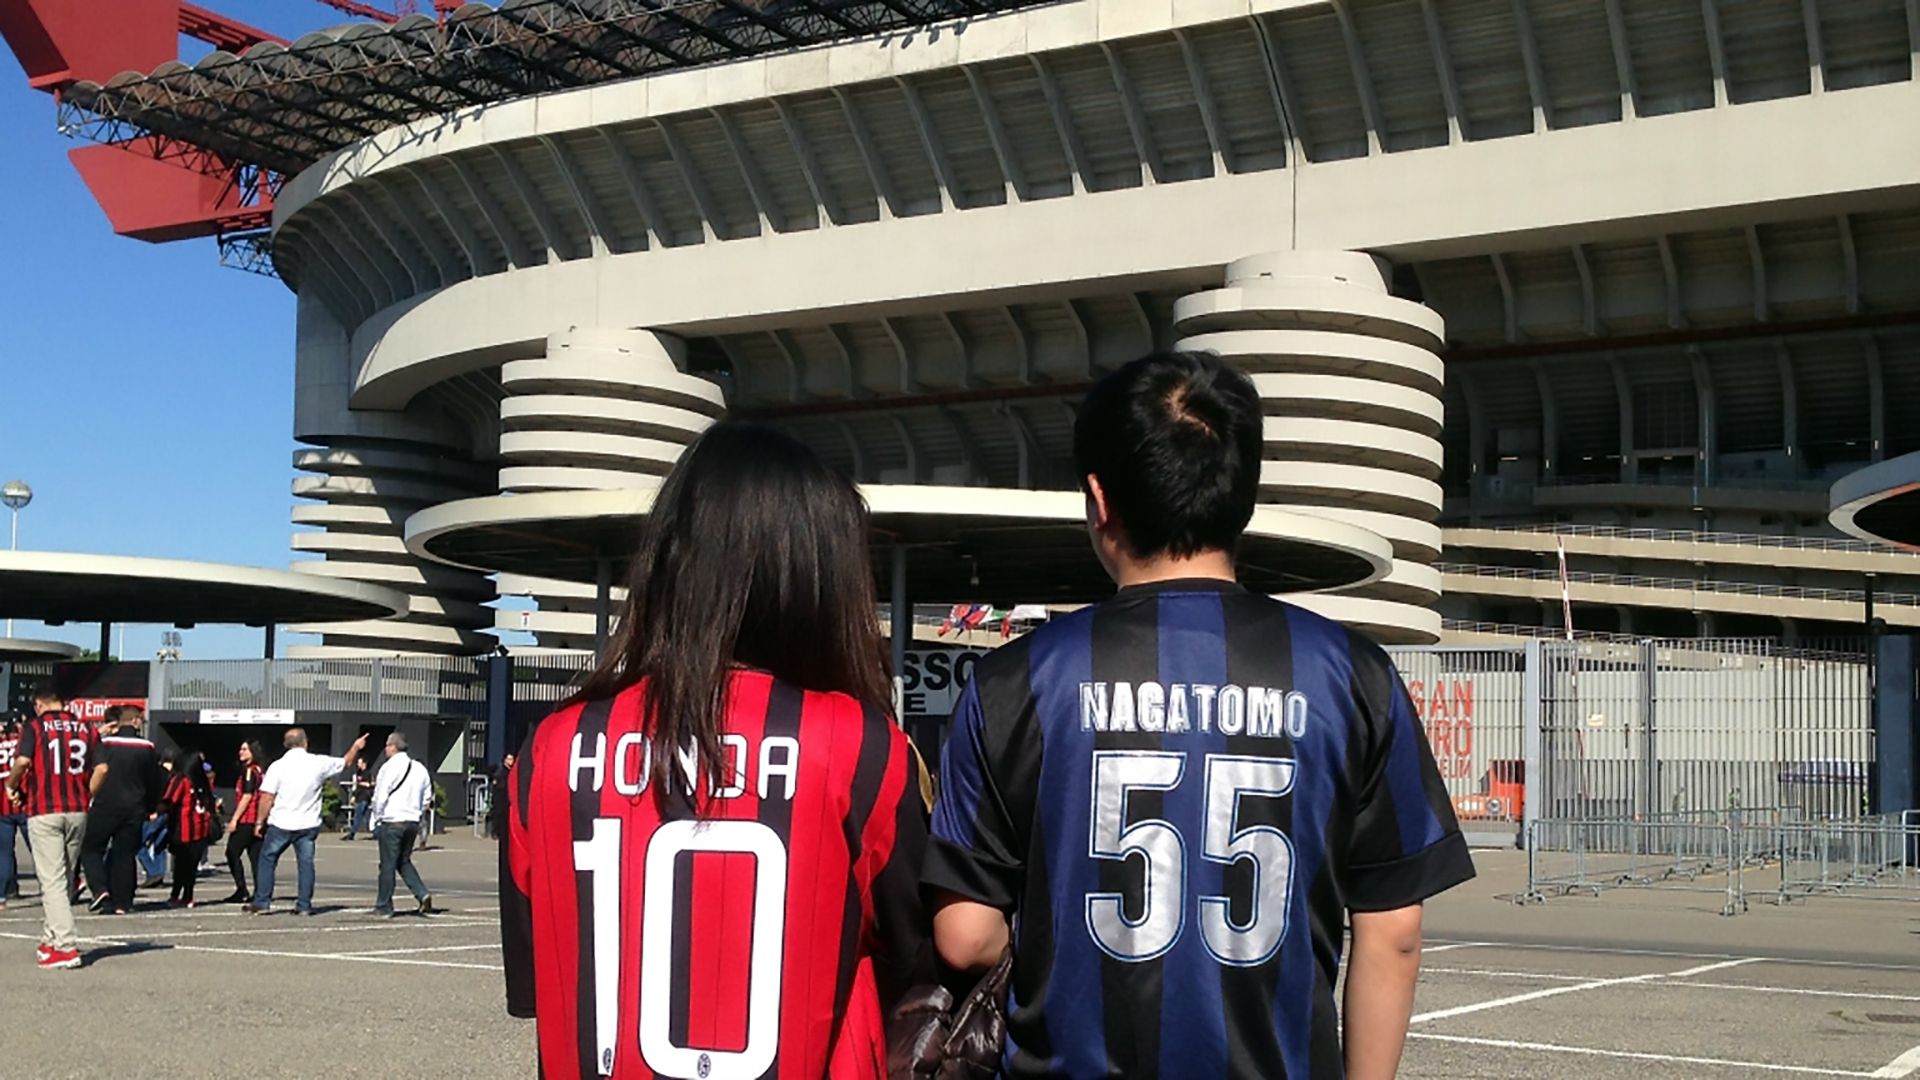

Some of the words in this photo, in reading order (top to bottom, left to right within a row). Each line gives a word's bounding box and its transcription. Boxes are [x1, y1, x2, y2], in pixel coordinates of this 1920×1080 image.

[43, 720, 89, 733] NESTA
[1079, 681, 1308, 738] NAGATOMO
[1408, 680, 1472, 717] SAN
[48, 738, 87, 775] 13
[568, 732, 800, 800] HONDA
[1085, 750, 1297, 967] 55
[573, 818, 788, 1080] 10
